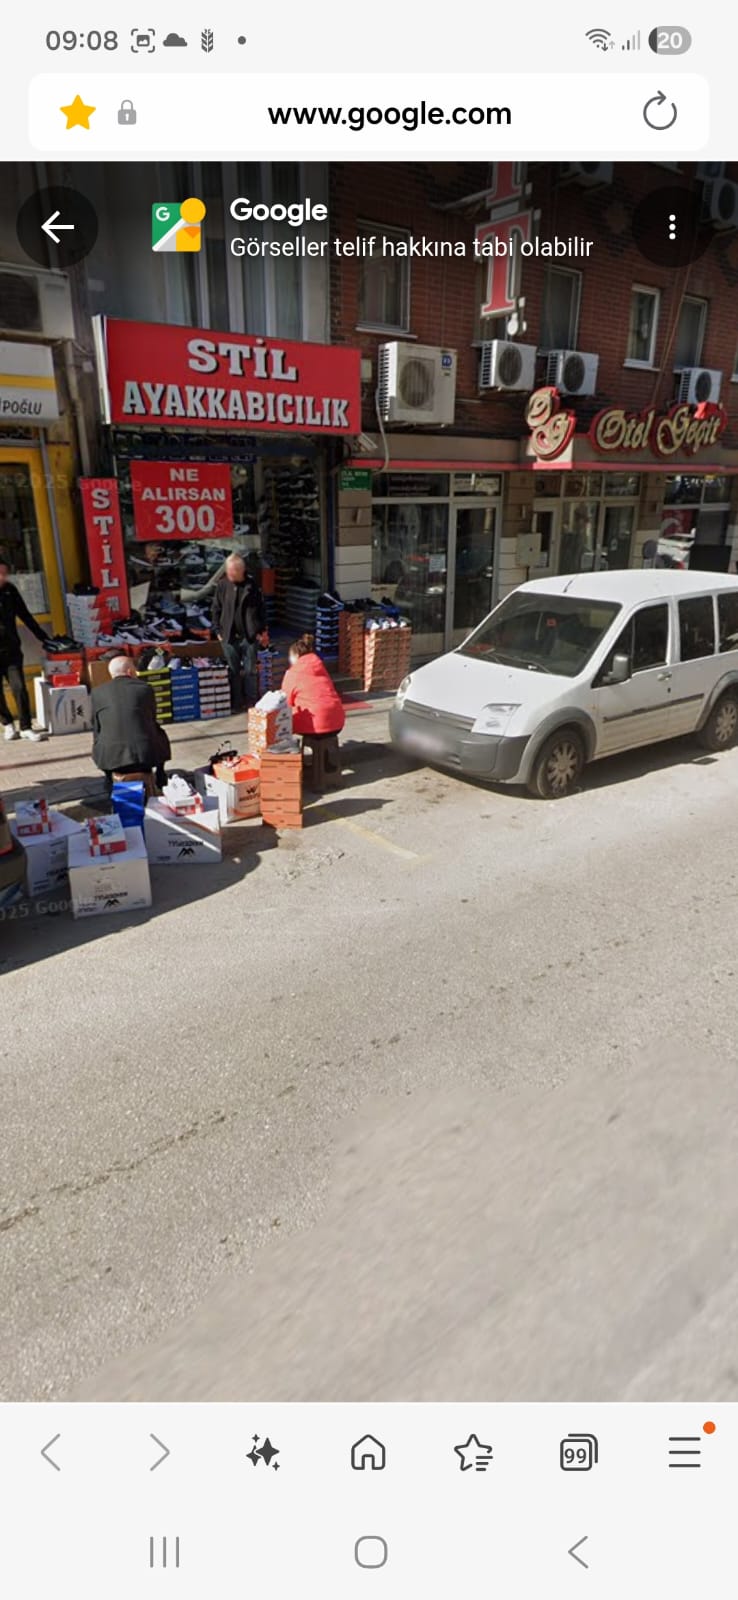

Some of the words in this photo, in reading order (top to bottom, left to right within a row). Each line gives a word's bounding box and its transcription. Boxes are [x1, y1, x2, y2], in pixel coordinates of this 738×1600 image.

[46, 31, 118, 50] 09:08
[658, 32, 682, 49] 20
[268, 101, 511, 131] www.google.com
[230, 198, 327, 226] Google
[231, 236, 327, 256] Görseller
[334, 236, 375, 256] telif
[383, 236, 465, 256] hakkına
[473, 236, 512, 256] tabi
[521, 236, 593, 256] olabilir
[187, 338, 297, 382] STİL
[0, 396, 42, 415] POĞLU
[122, 380, 348, 427] AYAKKABICILIK
[170, 468, 199, 482] NE
[141, 487, 226, 501] ALIRSAN
[155, 505, 215, 534] 300
[91, 487, 119, 588] STİL
[565, 1448, 587, 1464] 99
